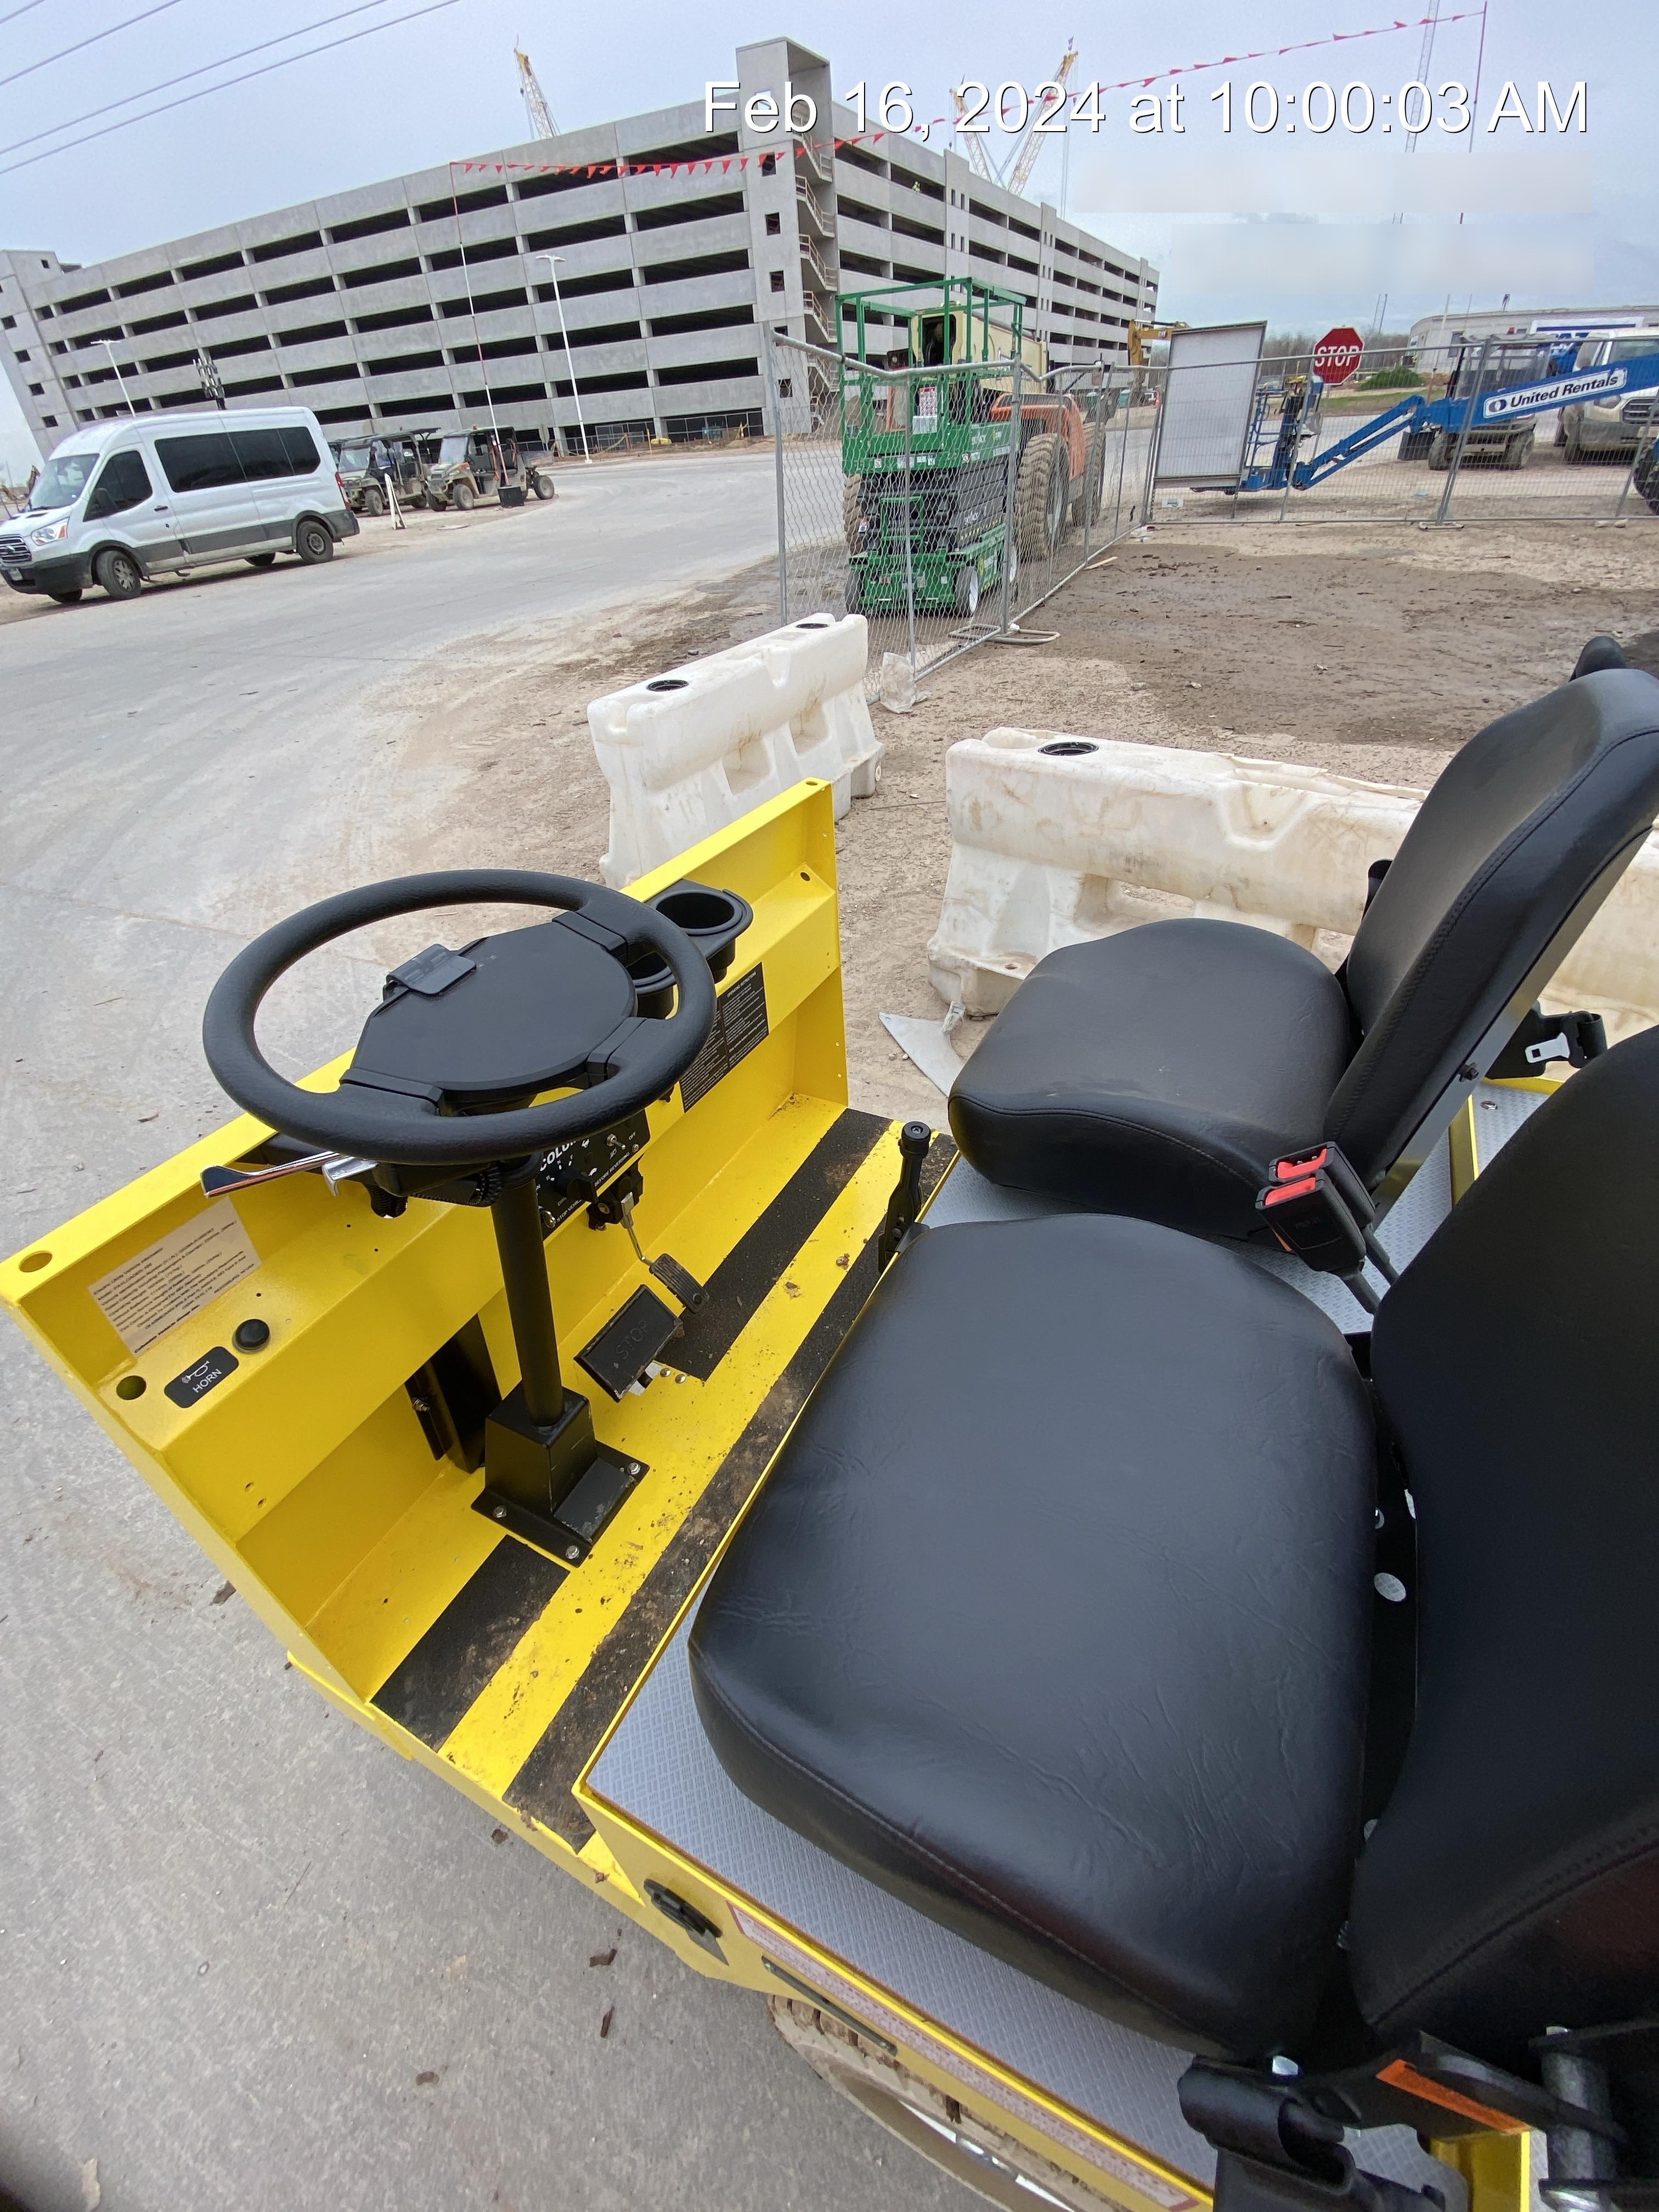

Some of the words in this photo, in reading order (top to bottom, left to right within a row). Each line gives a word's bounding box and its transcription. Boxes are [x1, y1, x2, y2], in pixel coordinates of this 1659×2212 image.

[1314, 345, 1359, 367] STOP
[1510, 387, 1559, 408] United
[1562, 376, 1619, 396] Rentals
[556, 1209, 568, 1223] STOP
[594, 1170, 610, 1187] BEFORE
[609, 1152, 630, 1173] REVERSING
[616, 1320, 647, 1359] STOP
[192, 1368, 222, 1393] HORN
